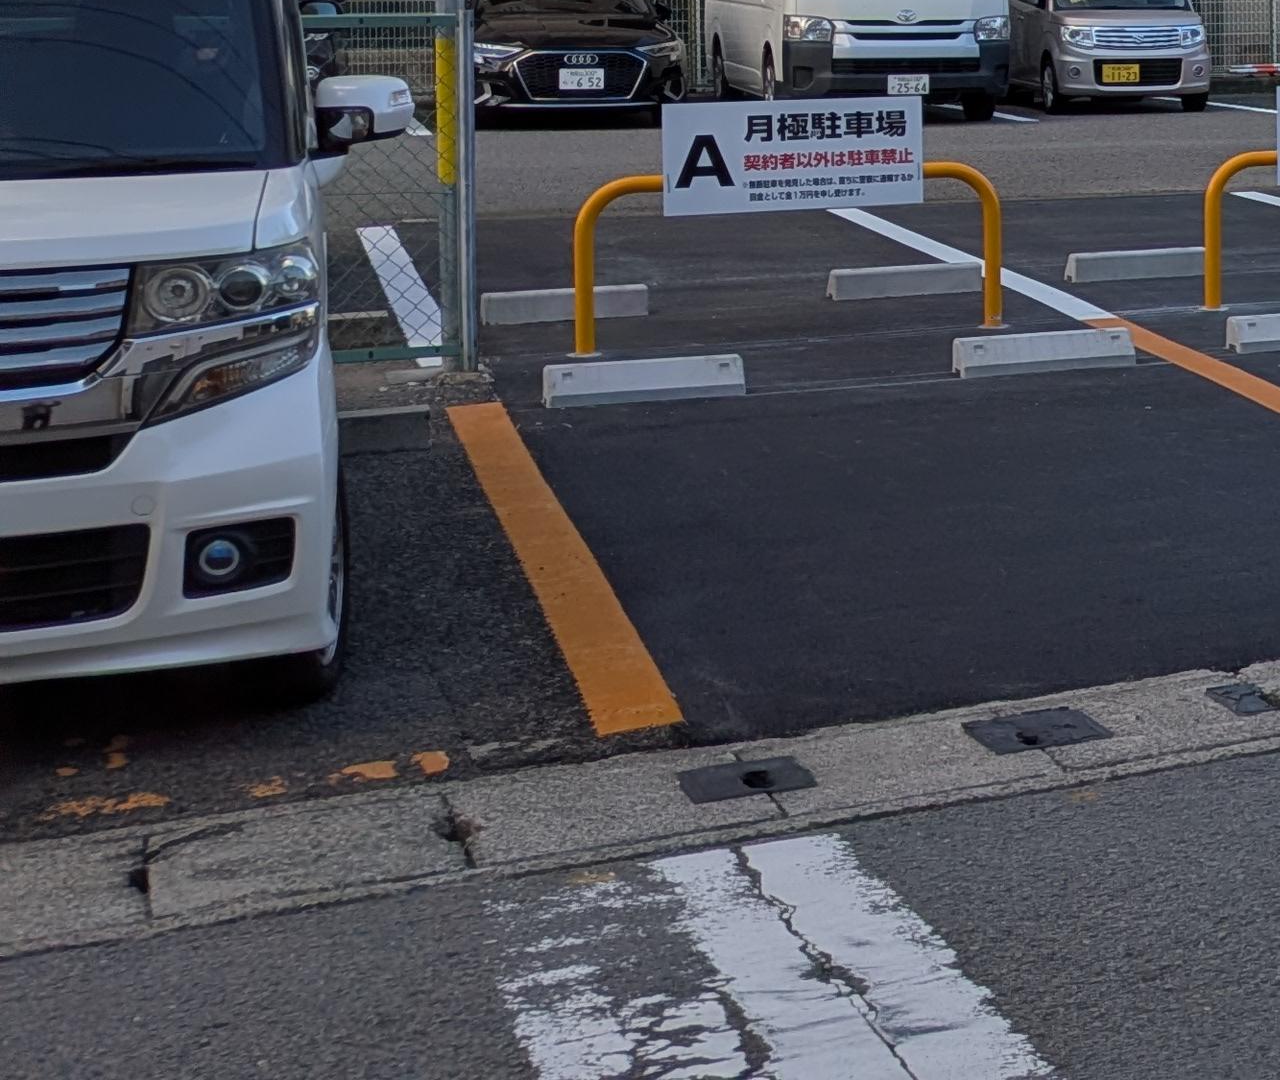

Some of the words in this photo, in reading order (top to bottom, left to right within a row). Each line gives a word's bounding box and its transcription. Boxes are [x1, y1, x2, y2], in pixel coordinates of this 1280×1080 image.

[744, 110, 907, 143] 月極駐車場
[674, 134, 736, 189] A
[743, 147, 914, 172] 契約者以外は駐車禁止
